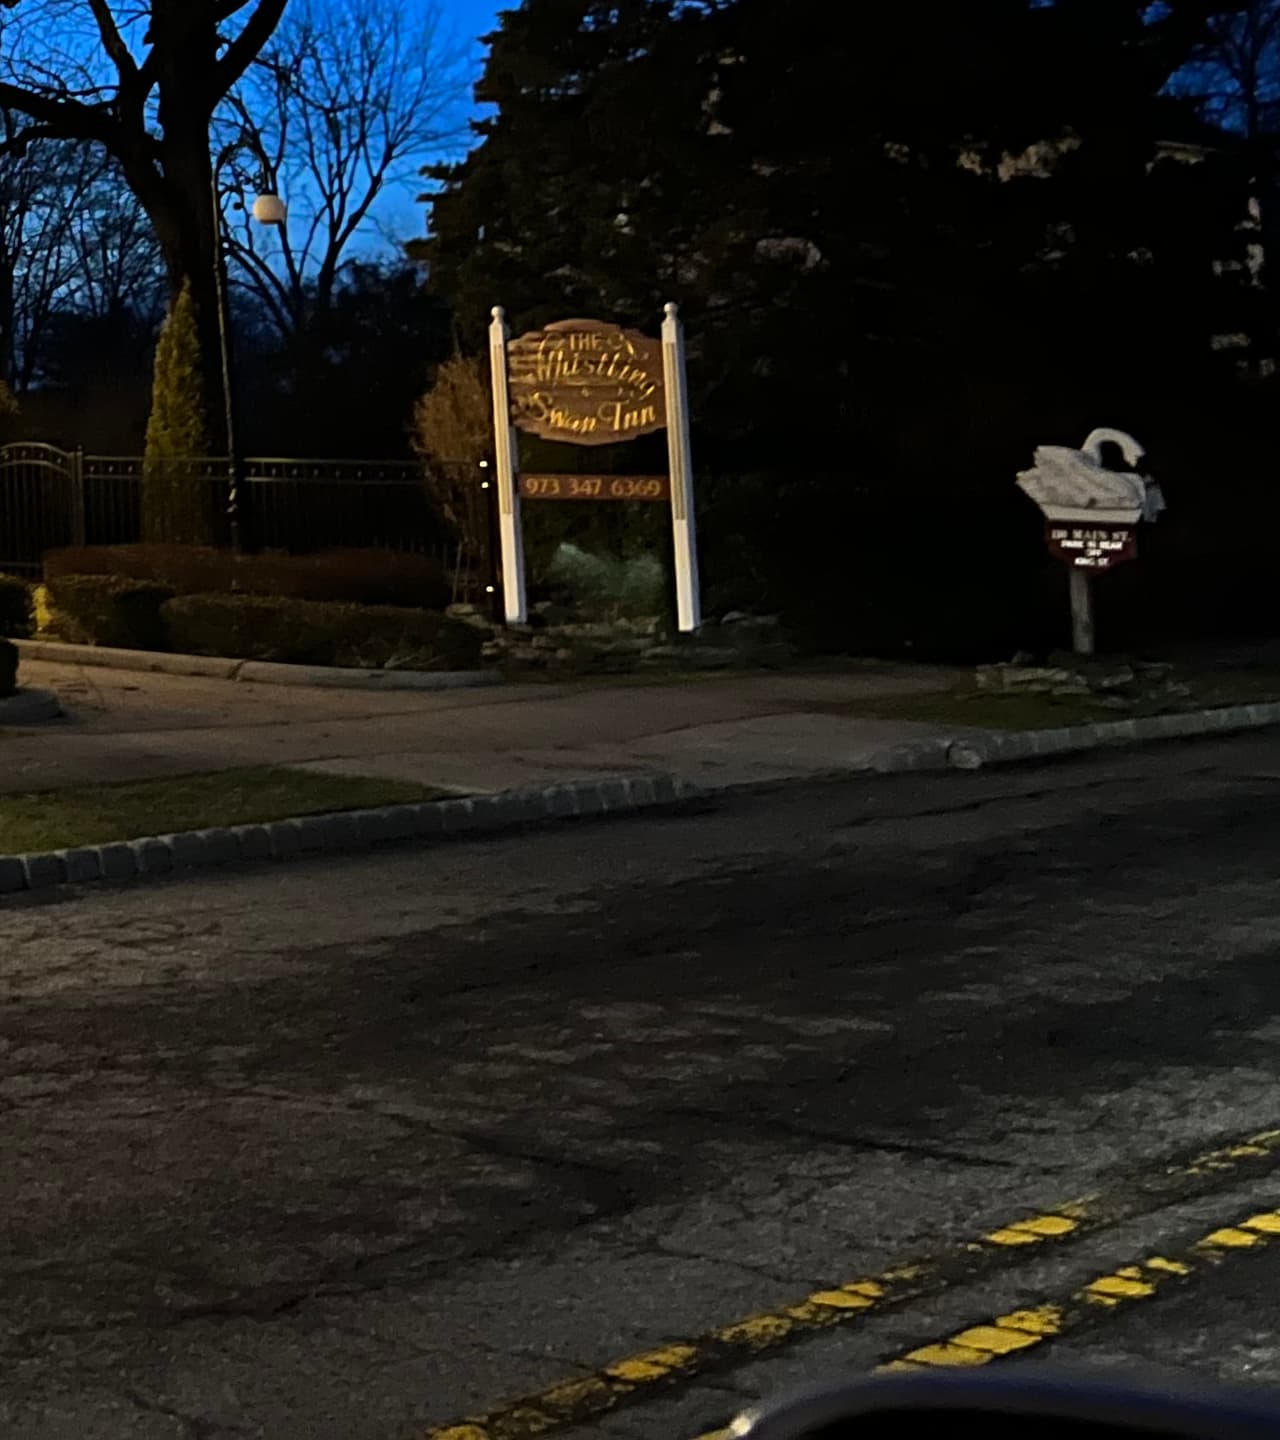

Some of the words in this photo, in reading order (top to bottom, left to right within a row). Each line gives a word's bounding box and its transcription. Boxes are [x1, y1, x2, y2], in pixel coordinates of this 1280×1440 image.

[570, 333, 602, 351] THE
[526, 392, 597, 433] Swan
[597, 400, 655, 431] Inn
[526, 478, 560, 495] 973
[568, 478, 602, 495] 347
[610, 479, 661, 496] 6369
